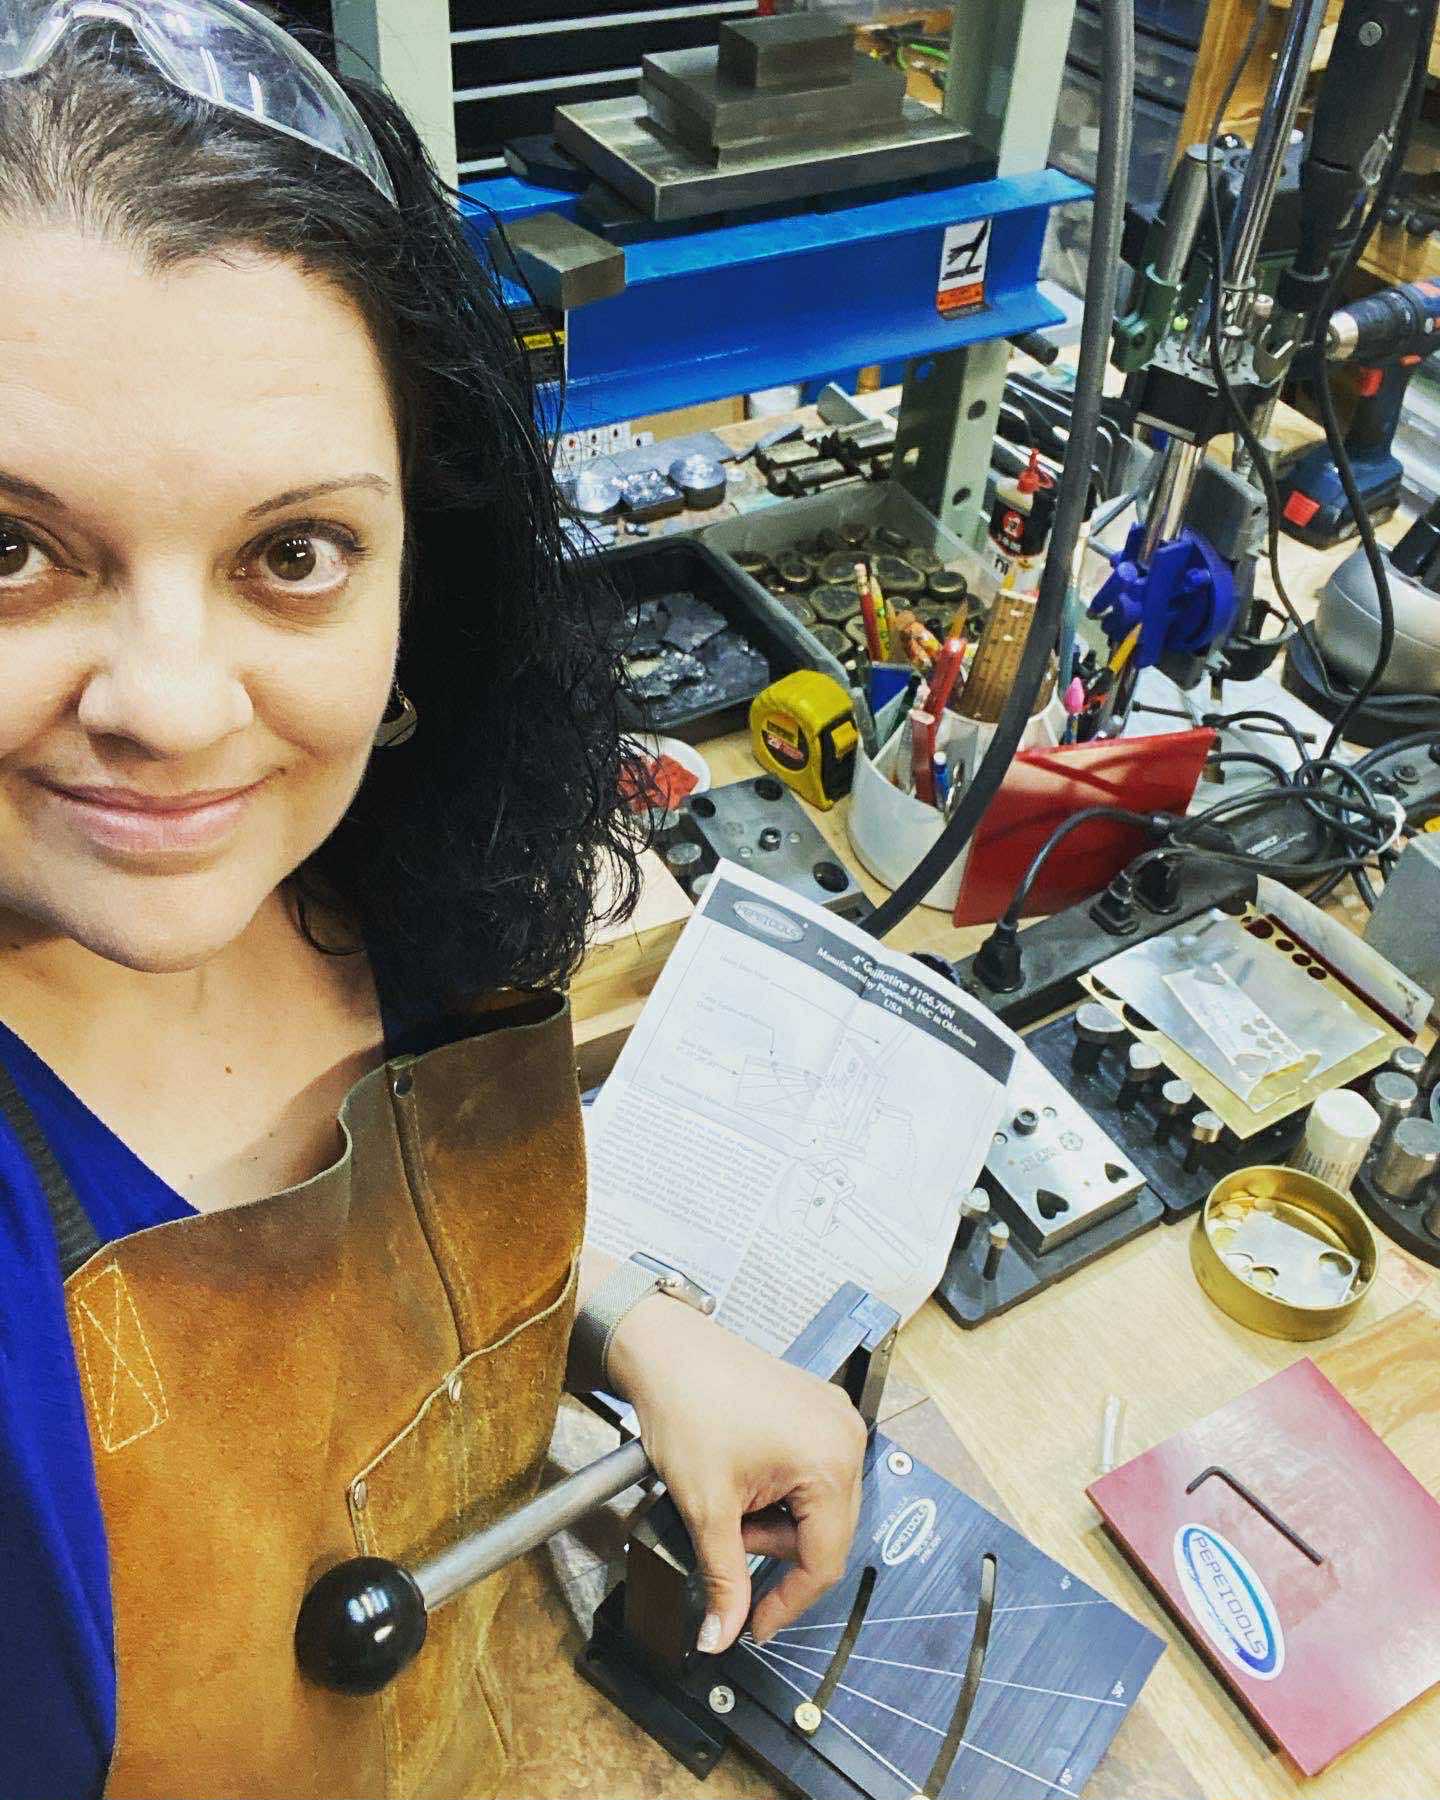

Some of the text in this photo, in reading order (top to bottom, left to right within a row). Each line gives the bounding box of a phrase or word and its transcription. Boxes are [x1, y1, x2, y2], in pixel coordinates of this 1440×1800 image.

[816, 947, 869, 983] Manufactured
[916, 1004, 934, 1019] INC
[863, 961, 910, 993] Guillotine
[883, 999, 903, 1016] USA
[1192, 1535, 1267, 1654] PEPETOOLS
